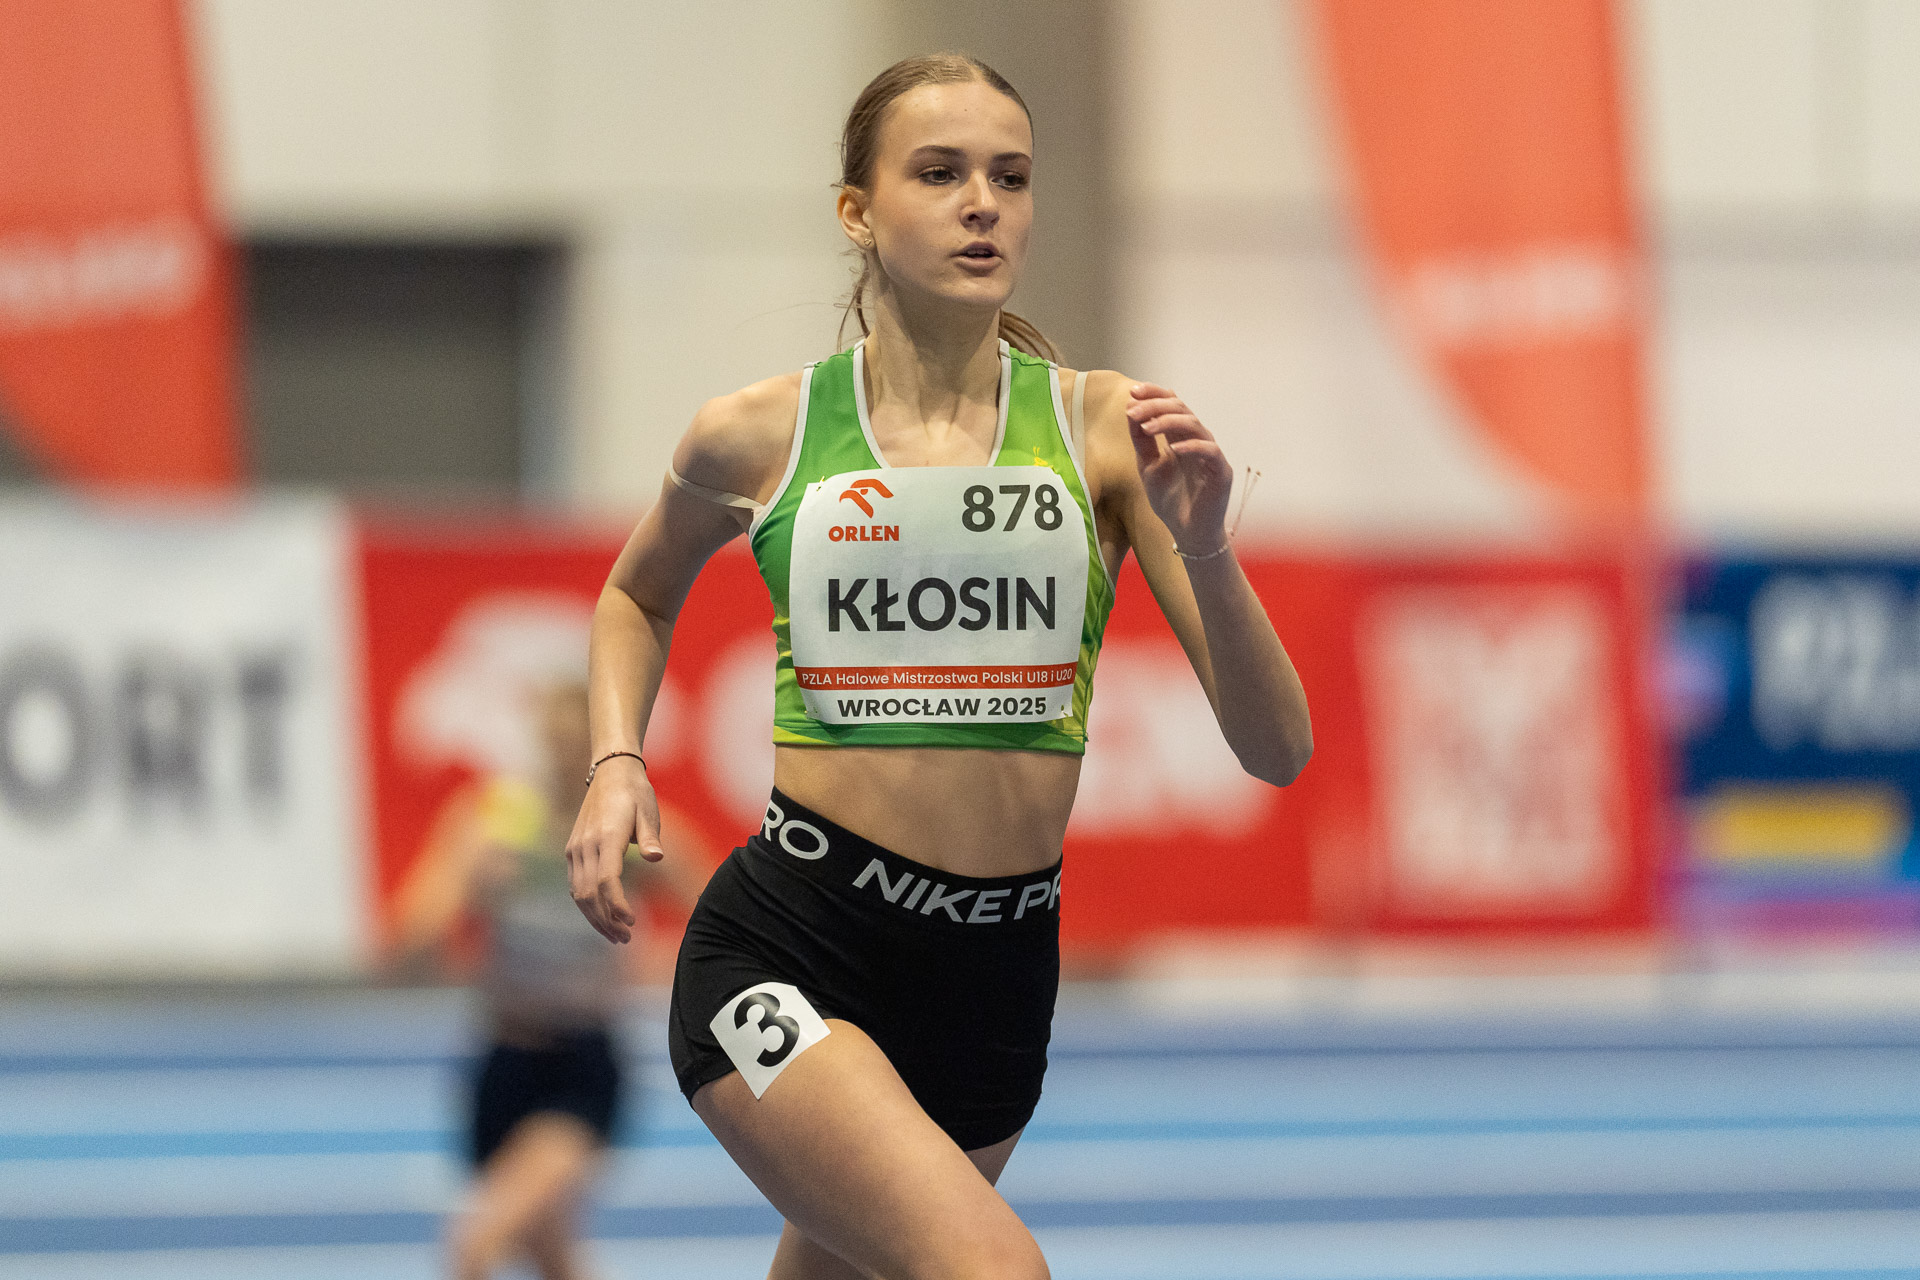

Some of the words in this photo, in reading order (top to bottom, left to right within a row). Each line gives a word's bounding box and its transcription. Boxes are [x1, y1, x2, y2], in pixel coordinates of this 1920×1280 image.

[961, 483, 1063, 533] 878
[828, 525, 900, 542] ORLEN
[828, 576, 1056, 632] KŁOSIN
[802, 672, 832, 685] PZLA
[836, 671, 889, 685] Halowe
[893, 671, 978, 685] Mistrzostwa
[982, 670, 1023, 684] Polski
[1027, 670, 1048, 684] U18
[1051, 670, 1054, 682] i
[1056, 668, 1073, 682] U20
[837, 698, 981, 717] WROCŁAW
[987, 696, 1047, 716] 2025
[852, 858, 1012, 924] NIKE
[734, 992, 800, 1067] 3
